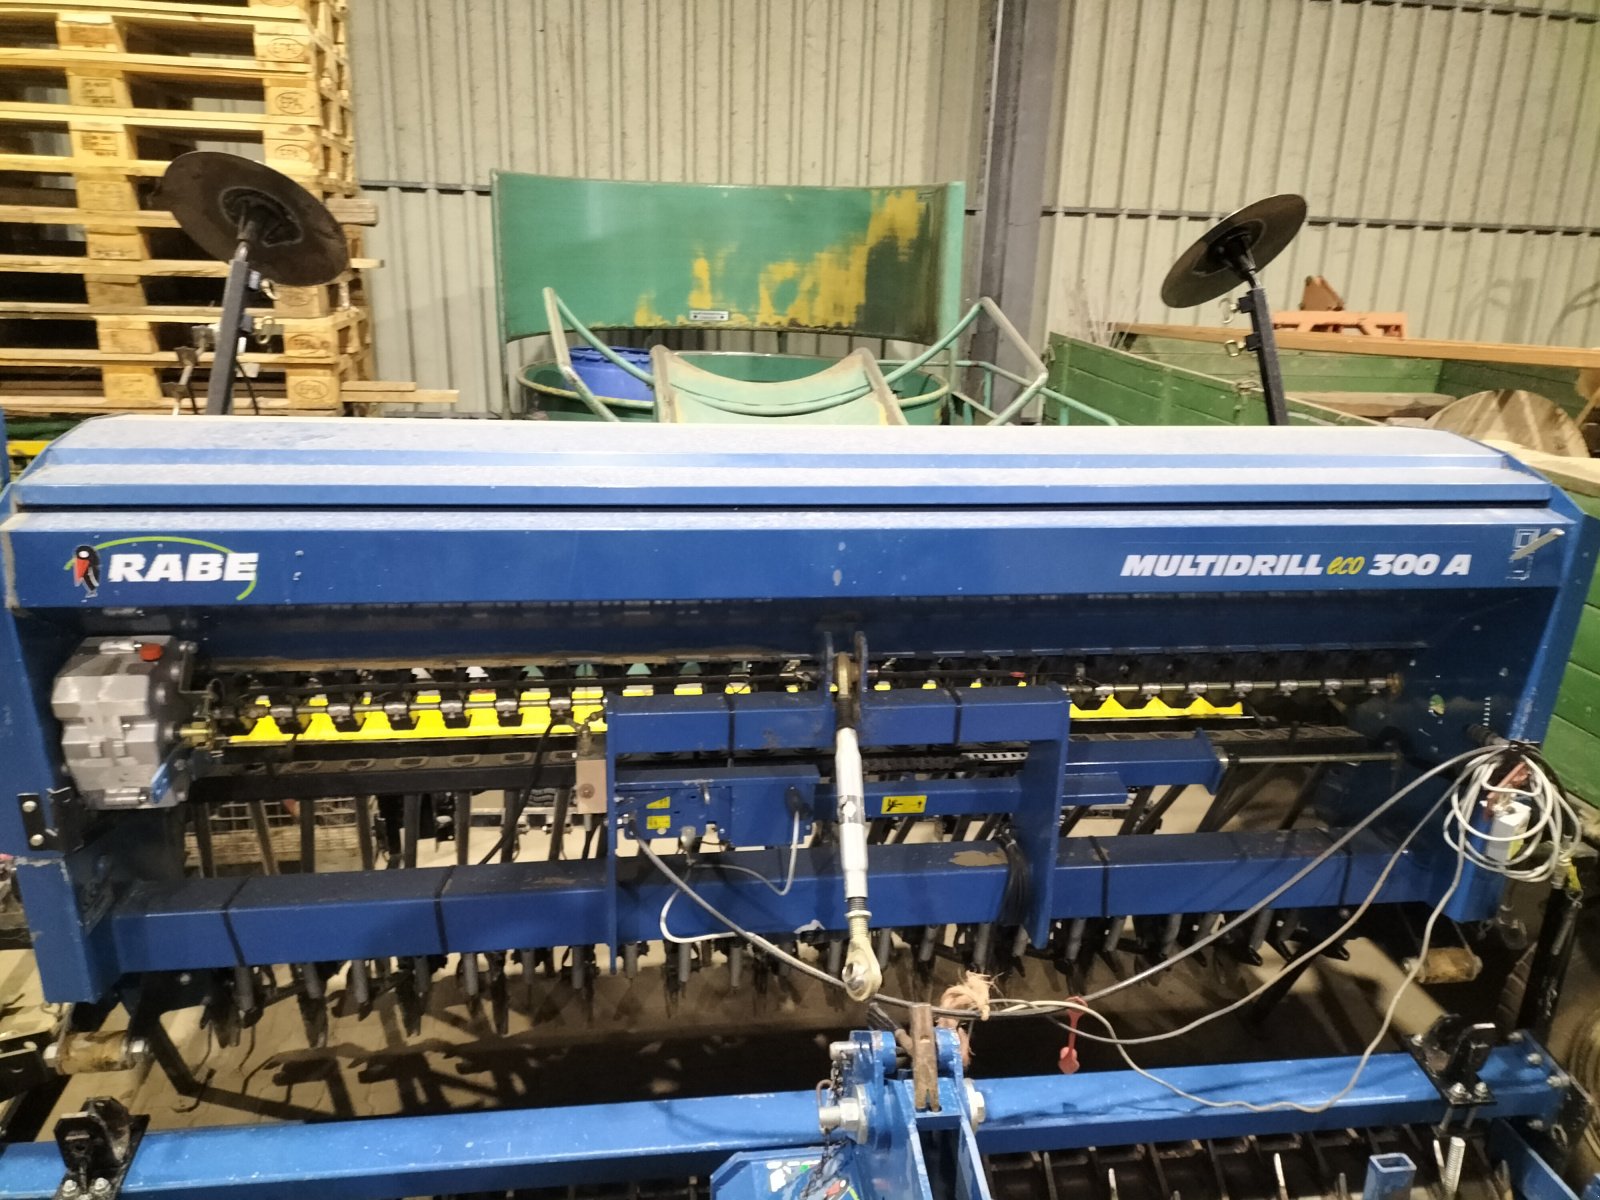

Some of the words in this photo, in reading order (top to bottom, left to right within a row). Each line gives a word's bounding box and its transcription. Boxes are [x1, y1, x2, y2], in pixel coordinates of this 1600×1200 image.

[108, 552, 259, 582] RABE
[1120, 554, 1325, 577] MULTIDRILL
[1326, 556, 1365, 575] eco
[1367, 553, 1441, 576] 300
[1441, 554, 1472, 576] A
